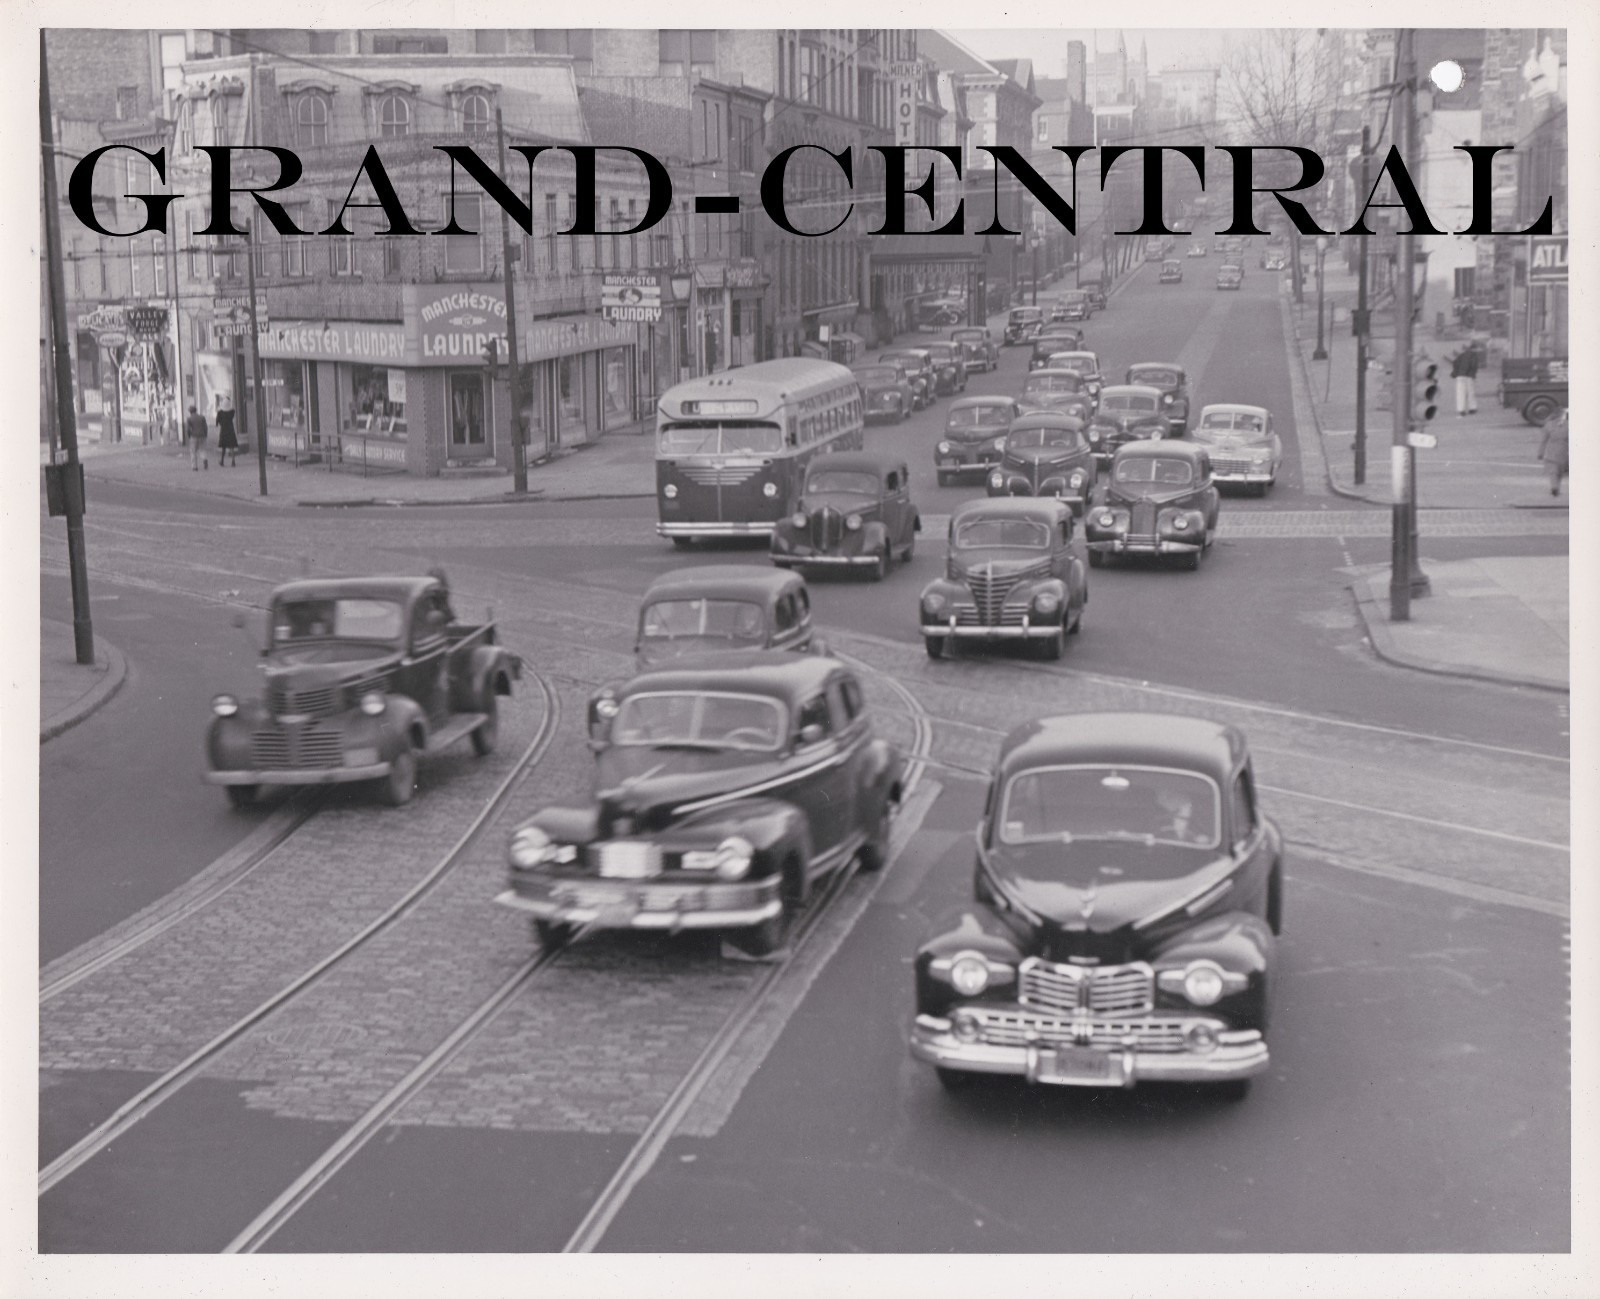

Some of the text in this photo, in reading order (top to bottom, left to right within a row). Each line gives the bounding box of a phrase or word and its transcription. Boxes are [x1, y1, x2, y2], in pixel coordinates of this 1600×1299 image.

[890, 64, 921, 76] MILNER
[605, 275, 657, 286] MANCHESTER
[215, 296, 266, 308] MANCHESER
[129, 310, 164, 320] VALLEY
[603, 306, 662, 322] LAUNDRY
[258, 328, 405, 358] MANCHESTER LAUNDRY
[526, 321, 590, 361] MANCHESTER
